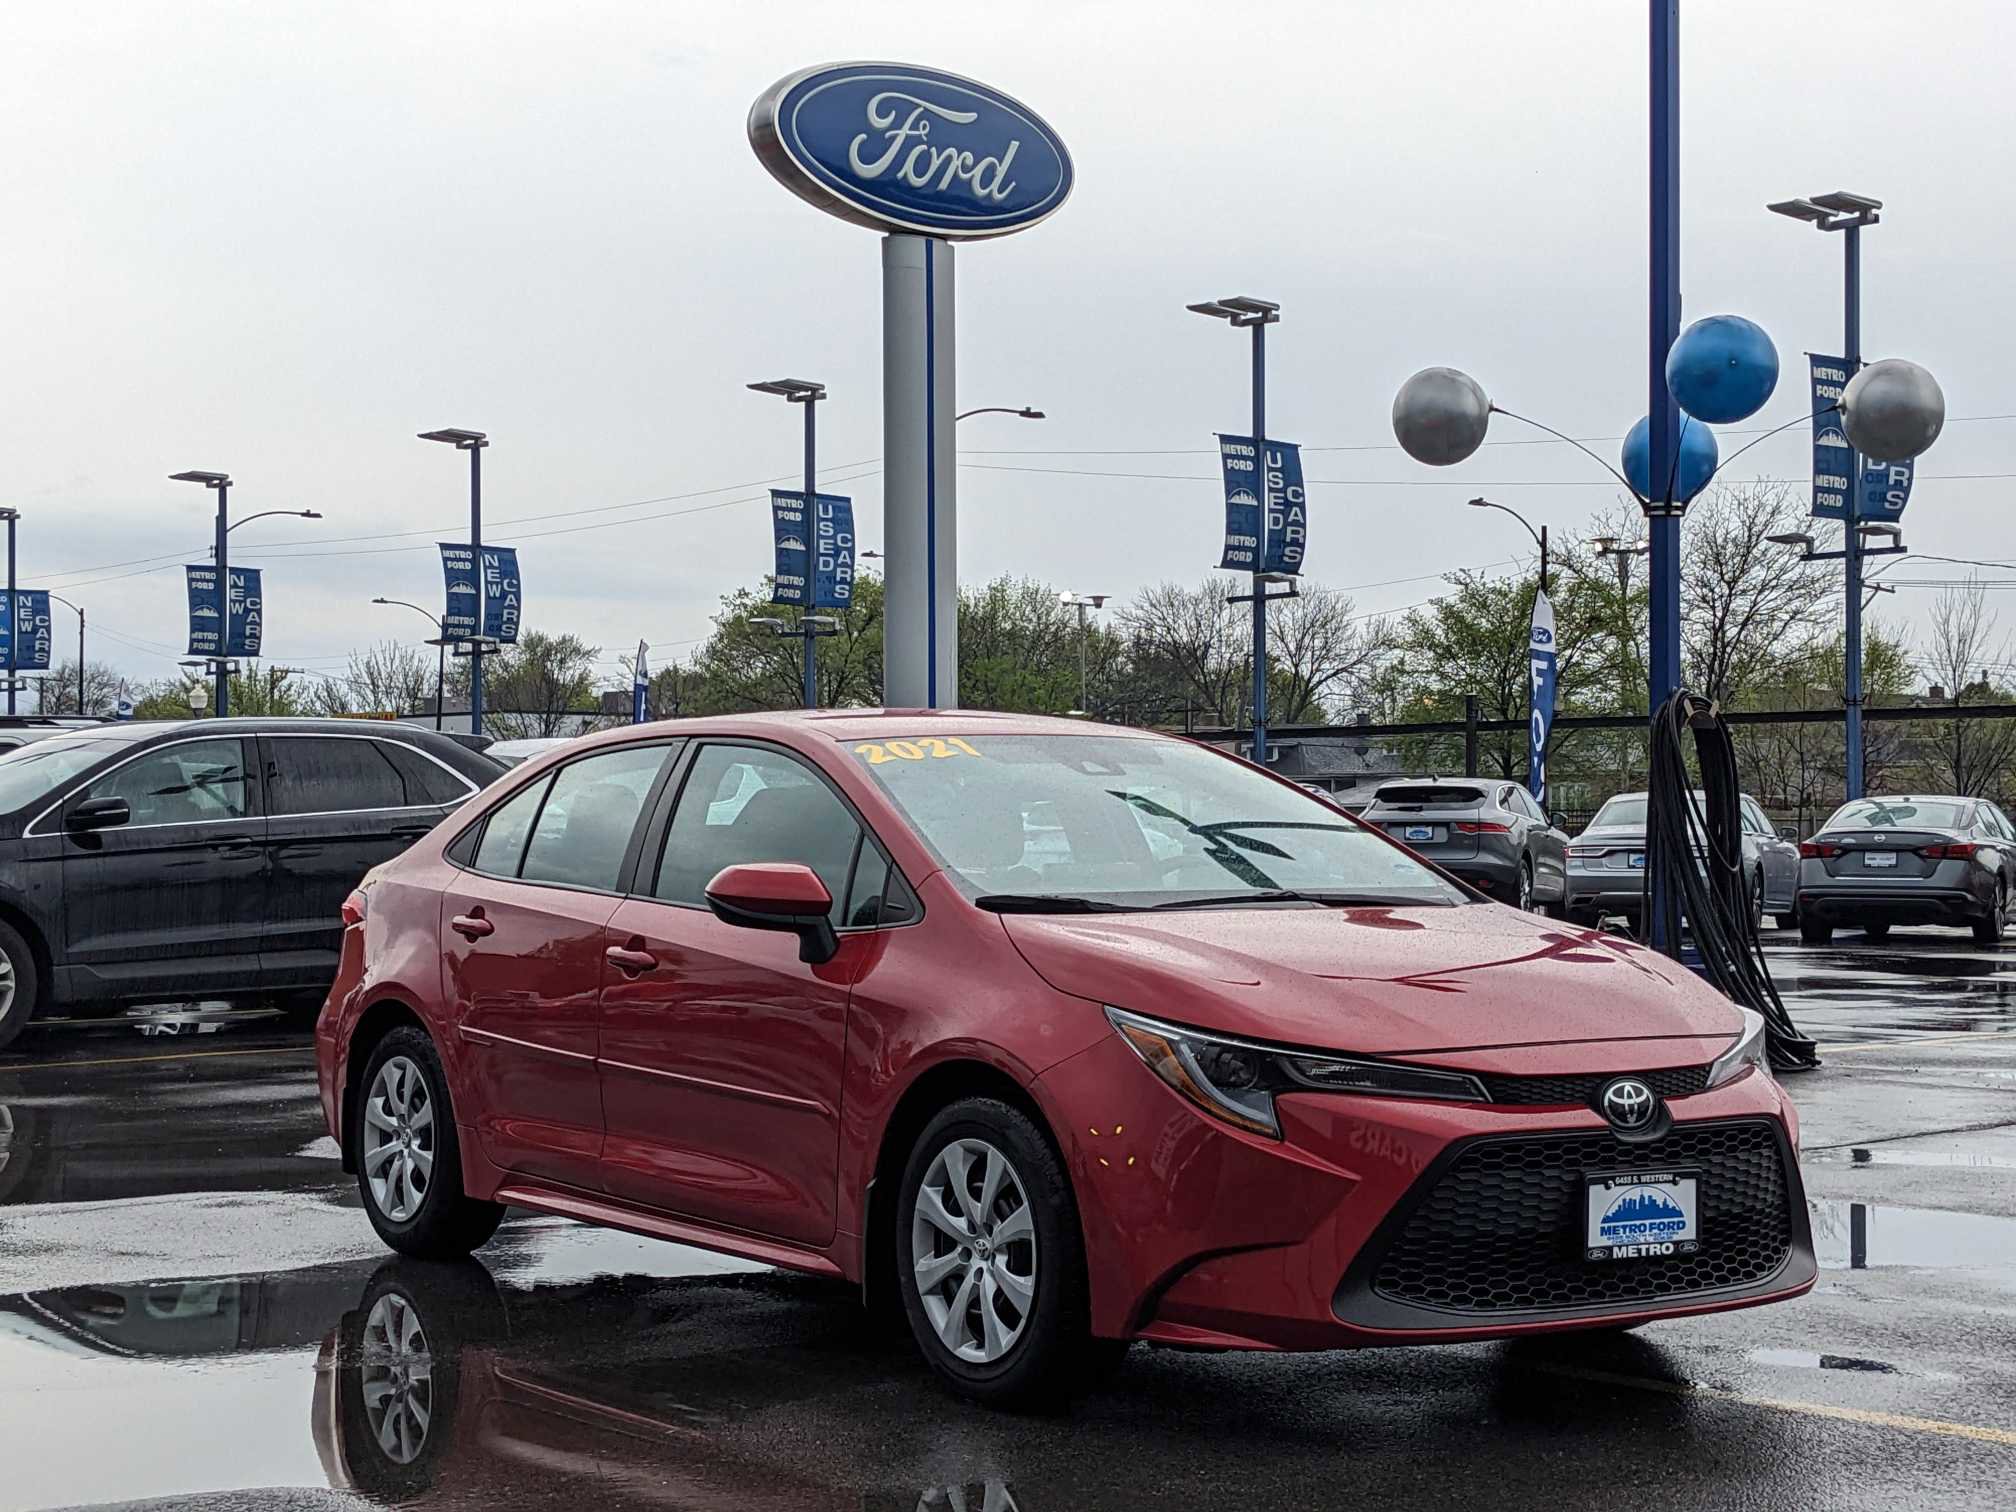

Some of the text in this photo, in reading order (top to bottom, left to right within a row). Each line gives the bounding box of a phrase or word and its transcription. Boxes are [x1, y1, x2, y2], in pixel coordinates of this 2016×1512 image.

[849, 92, 1020, 201] Ford
[1813, 366, 1845, 382] METRO
[1222, 443, 1255, 457] METRO
[1226, 459, 1254, 471] FORD
[1815, 474, 1848, 490] METRO
[1266, 450, 1285, 530] USED
[773, 497, 804, 509] METRO
[1816, 493, 1843, 507] FORD
[777, 510, 802, 522] FORD
[1283, 486, 1305, 563] CARS
[818, 503, 835, 572] USED
[1226, 535, 1257, 548] METRO
[442, 549, 472, 559] METRO
[1227, 550, 1253, 563] FORD
[446, 561, 472, 570] FORD
[834, 533, 853, 599] CARS
[188, 571, 216, 580] METRO
[484, 553, 501, 598] NEW
[776, 574, 805, 587] METRO
[191, 581, 215, 590] FORD
[229, 574, 245, 615] NEW
[777, 587, 801, 599] FORD
[19, 595, 33, 633] NEW
[500, 578, 518, 637] CARS
[244, 597, 261, 650] CARS
[447, 615, 475, 625] METRO
[191, 631, 218, 641] METRO
[447, 627, 471, 636] FORD
[34, 615, 49, 663] CARS
[192, 642, 215, 650] FORD
[854, 737, 981, 765] 2021
[1600, 1220, 1687, 1237] METRO FORD
[1612, 1242, 1674, 1259] METRO
